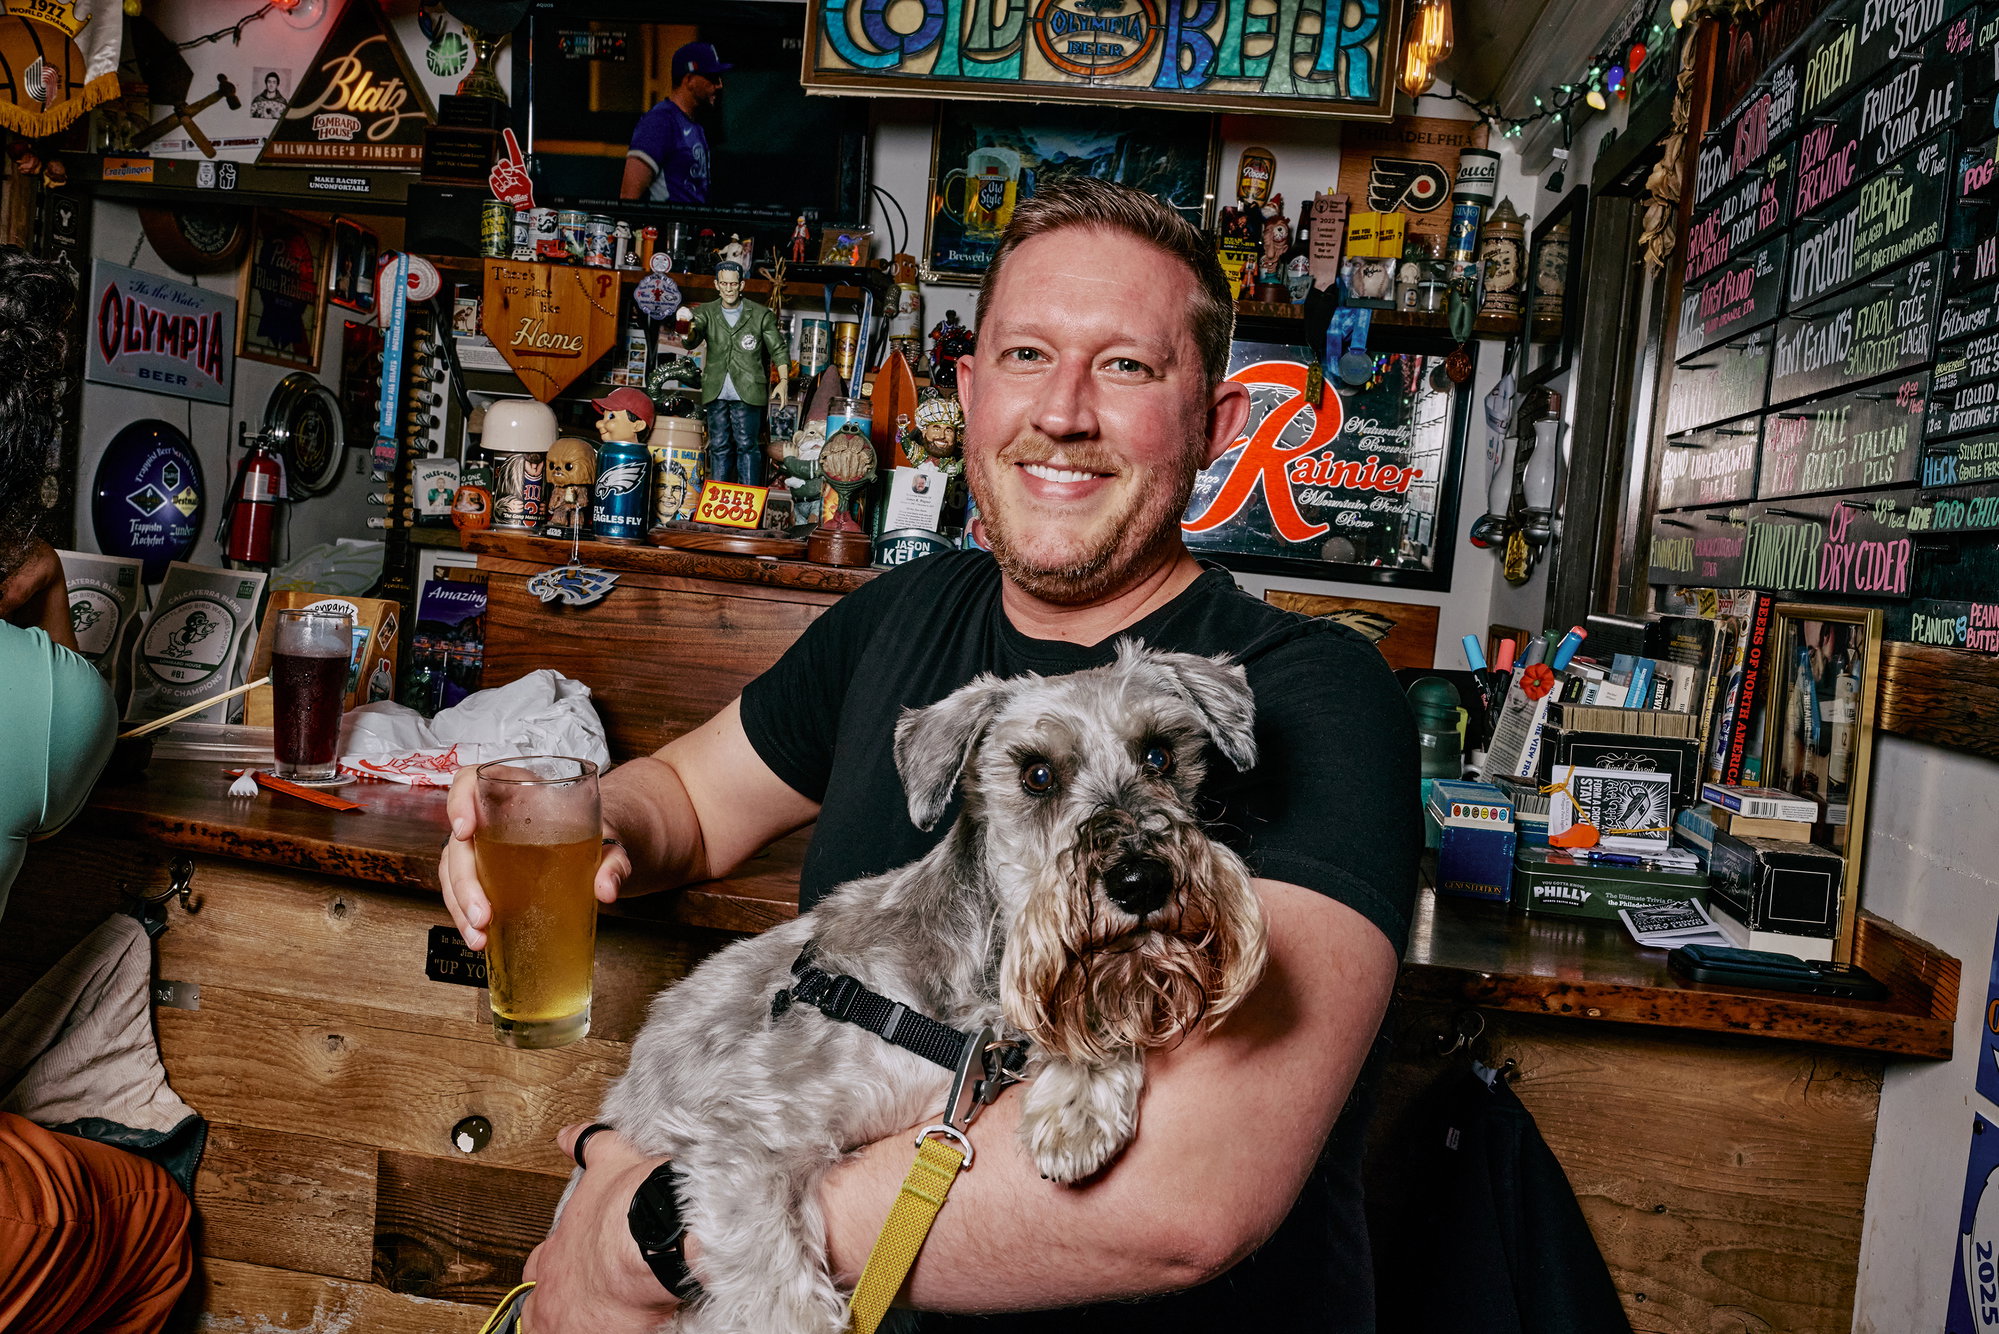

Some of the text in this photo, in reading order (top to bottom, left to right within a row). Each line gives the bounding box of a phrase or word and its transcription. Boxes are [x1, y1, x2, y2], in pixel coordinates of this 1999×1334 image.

[28, 0, 65, 19] 1977
[9, 7, 74, 35] WORLD CHAMPS
[1049, 9, 1143, 42] OLYMPIA
[1066, 39, 1126, 57] BEER
[285, 34, 427, 141] Blatz
[1860, 62, 1921, 141] FRUITED
[313, 114, 360, 131] LOMBARD
[1876, 81, 1954, 165] SOUR ALE
[319, 128, 353, 139] HOUSE
[1359, 127, 1474, 148] PHILADELPHIA
[273, 143, 355, 156] MILWAUKEE'S
[362, 146, 403, 158] FINEST
[1798, 124, 1835, 177] BEND
[314, 176, 366, 185] MAKE RACISTS
[1695, 145, 1722, 204] FEED
[1796, 140, 1857, 218] BREWING
[309, 182, 370, 192] UNCOMFORTABLE
[988, 181, 1003, 194] Old
[981, 189, 1002, 209] Style
[1758, 198, 1779, 231] RED
[948, 249, 985, 262] Brewed
[1790, 205, 1859, 302] UPRIGHT
[150, 284, 169, 299] the
[505, 285, 553, 299] no place
[540, 302, 561, 314] like
[97, 281, 224, 386] OLYMPIA
[510, 317, 584, 351] Home
[1803, 308, 1853, 372] GIANTS
[1855, 299, 1894, 340] FLORAL
[1897, 293, 1926, 327] RICE
[1844, 323, 1929, 376] SACRIFICE LAGER
[138, 367, 188, 386] BEER
[1970, 355, 1991, 377] THC
[1954, 383, 1995, 410] LIQUID
[1344, 416, 1411, 443] Naturally
[1812, 405, 1850, 450] PALE
[1948, 406, 1992, 433] ROTATING
[1181, 361, 1423, 543] Rainier
[1849, 423, 1908, 464] ITALIAN
[1959, 443, 1984, 461] SILVER
[1863, 455, 1895, 487] PILS
[1959, 463, 1983, 481] GENTLE
[708, 485, 755, 506] BEER
[1298, 488, 1410, 514] Mountain Fresh
[593, 506, 605, 515] FLY
[593, 514, 642, 526] EAGLES FLY
[702, 502, 758, 523] GOOD
[1335, 510, 1374, 529] Beer
[1933, 499, 1965, 530] TOPO
[895, 540, 930, 551] JASON
[1819, 538, 1910, 594] DRY CIDER
[168, 589, 242, 614] CALCATERRA BLEND
[194, 603, 211, 611] BIRD
[428, 587, 488, 608] Amazing
[1911, 613, 1955, 646] PEANUTS
[162, 674, 223, 697] OF CHAMPIONS
[1726, 596, 1772, 786] BEERS OF NORTH AMERICA
[1528, 739, 1540, 759] VIEW
[1580, 778, 1592, 801] STAY
[1593, 779, 1602, 800] FORM
[1533, 885, 1593, 903] PHILLY
[1618, 893, 1645, 901] Ultimate
[442, 935, 449, 943] In
[460, 949, 473, 958] Jim
[435, 958, 486, 979] "UP YO
[1975, 1241, 1997, 1326] 2025
